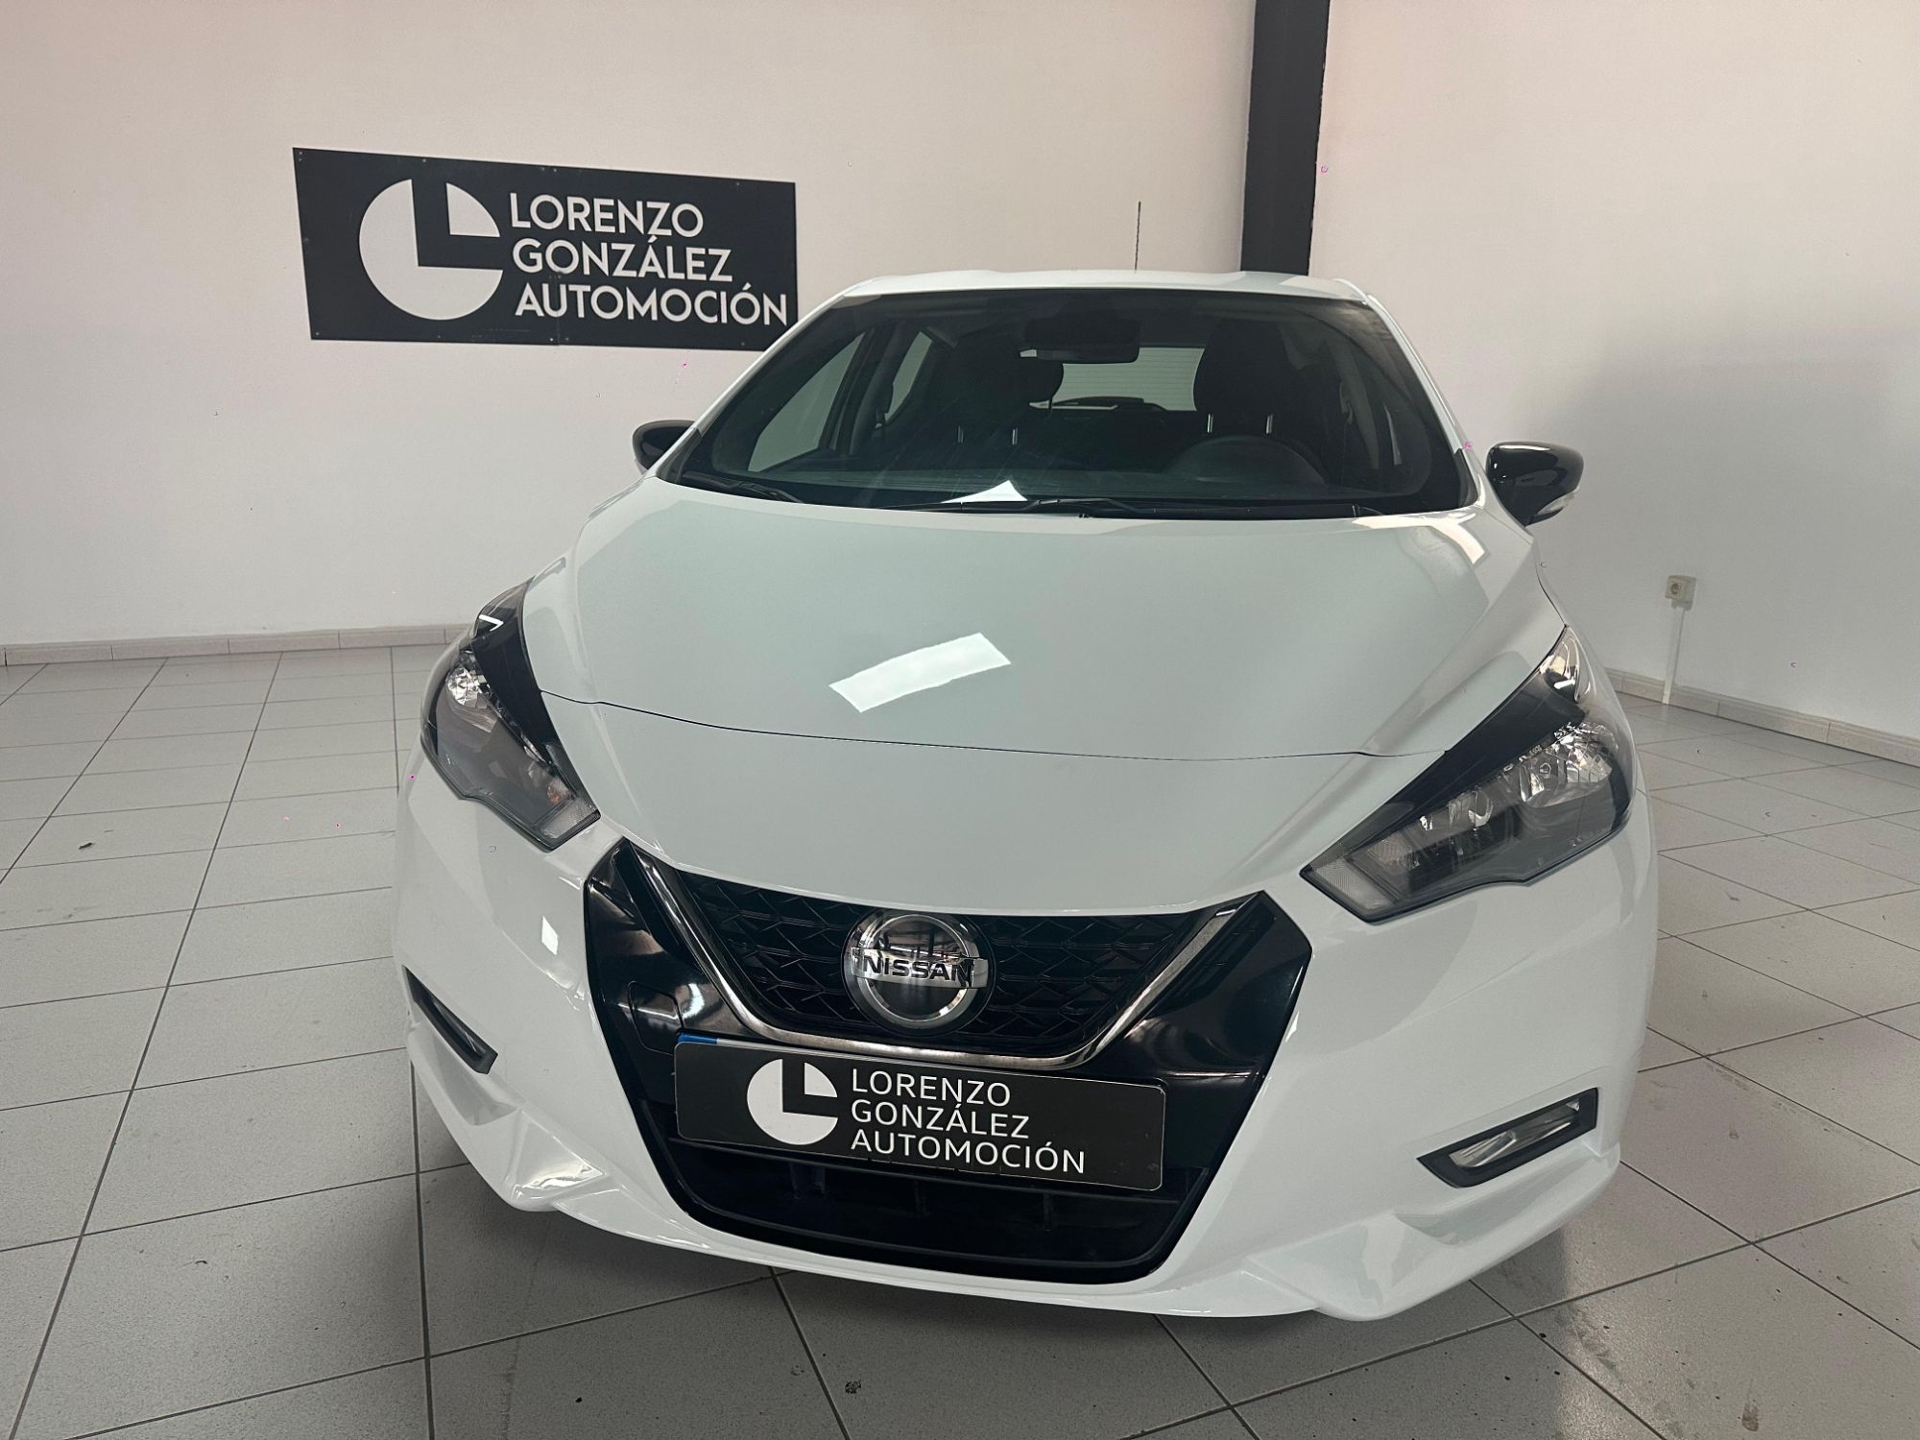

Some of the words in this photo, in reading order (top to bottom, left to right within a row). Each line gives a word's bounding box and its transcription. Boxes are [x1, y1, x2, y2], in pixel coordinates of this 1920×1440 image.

[509, 192, 704, 238] LORENZO
[512, 235, 733, 283] GONZÁLEZ
[514, 282, 788, 327] AUTOMOCIÓN
[862, 955, 975, 988] NISSAN
[852, 1068, 1011, 1107] LORENZO
[850, 1099, 1030, 1140] GONZÁLEZ
[850, 1128, 1085, 1174] AUTOMOCIÓN
